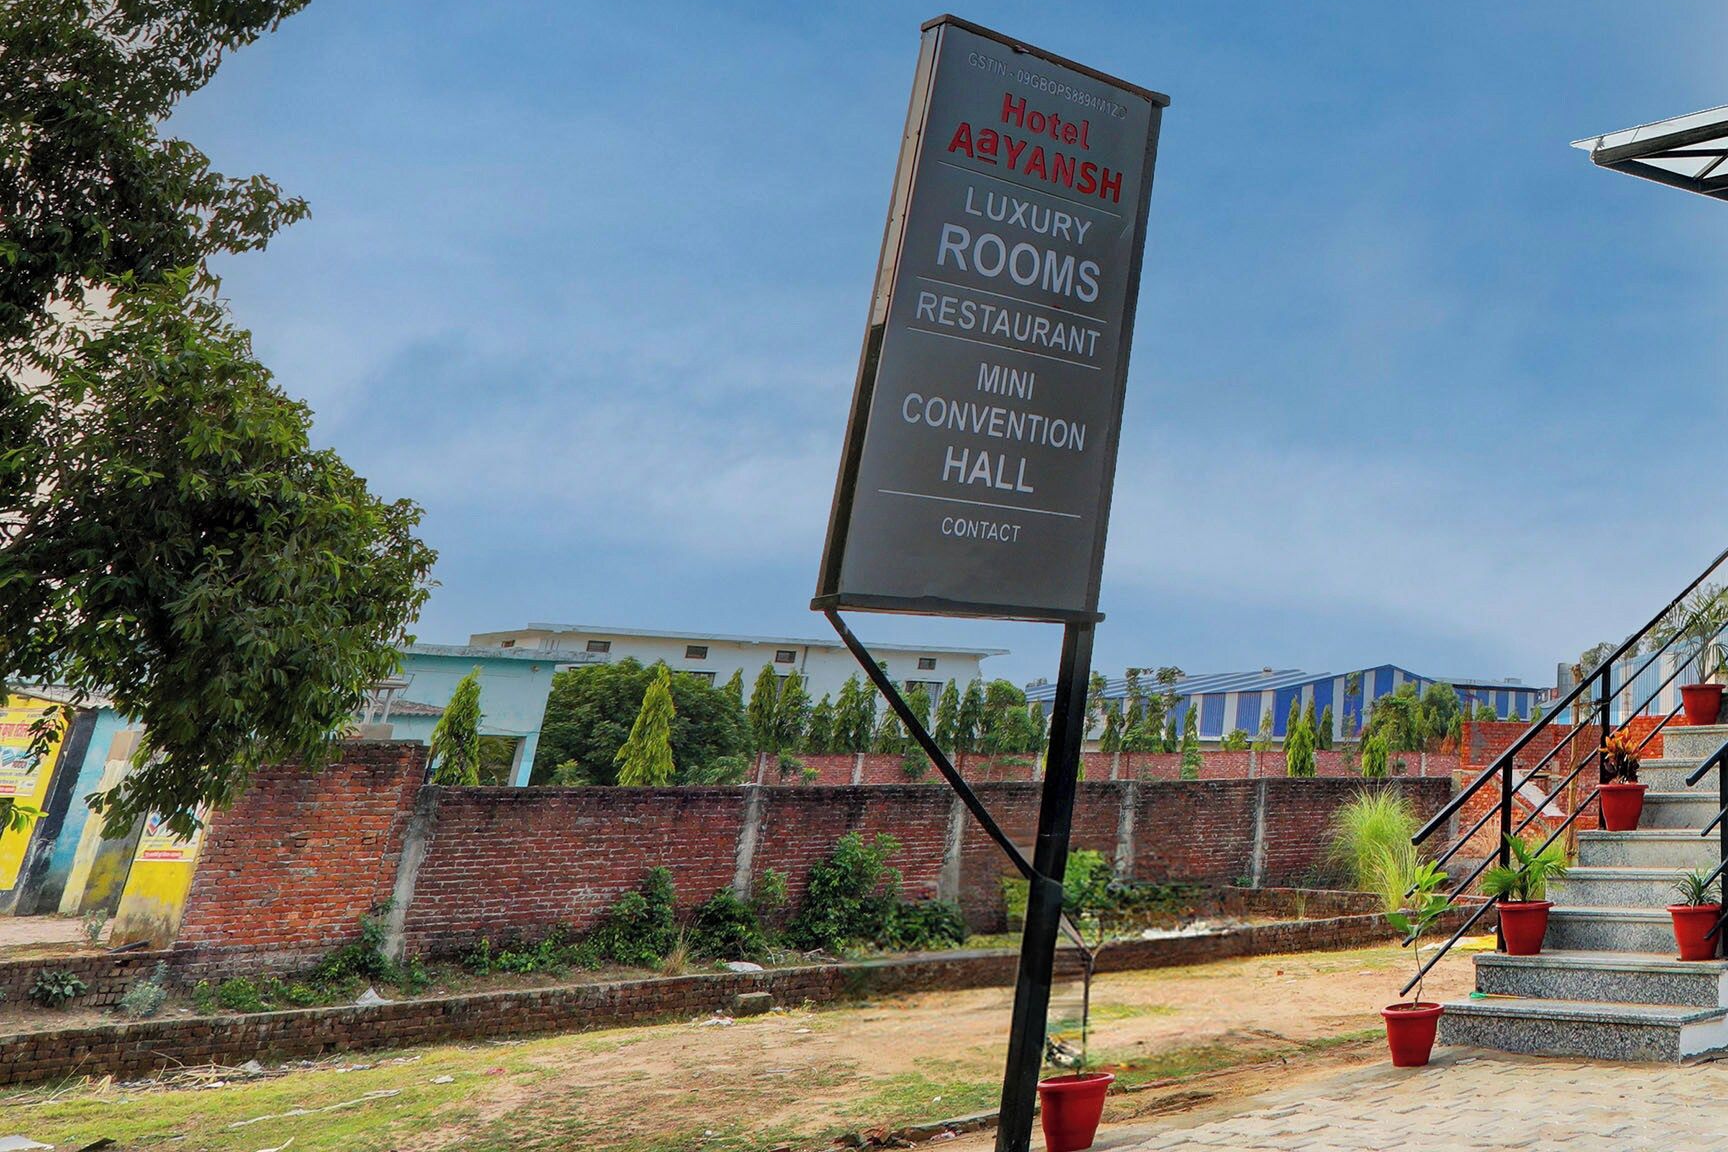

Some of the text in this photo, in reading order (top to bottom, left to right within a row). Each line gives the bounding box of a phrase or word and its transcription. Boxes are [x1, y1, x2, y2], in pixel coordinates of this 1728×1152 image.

[968, 52, 1008, 77] GSTIN
[1001, 92, 1090, 150] Hotel
[948, 121, 1123, 204] AaYANSH
[964, 186, 1092, 245] LUXURY
[936, 222, 1101, 303] ROOMS
[915, 293, 1101, 358] RESTAURANT
[976, 363, 1035, 401] MINI
[901, 392, 1087, 452] CONVENTION
[942, 446, 1035, 493] HALL
[941, 516, 1021, 542] CONTACT
